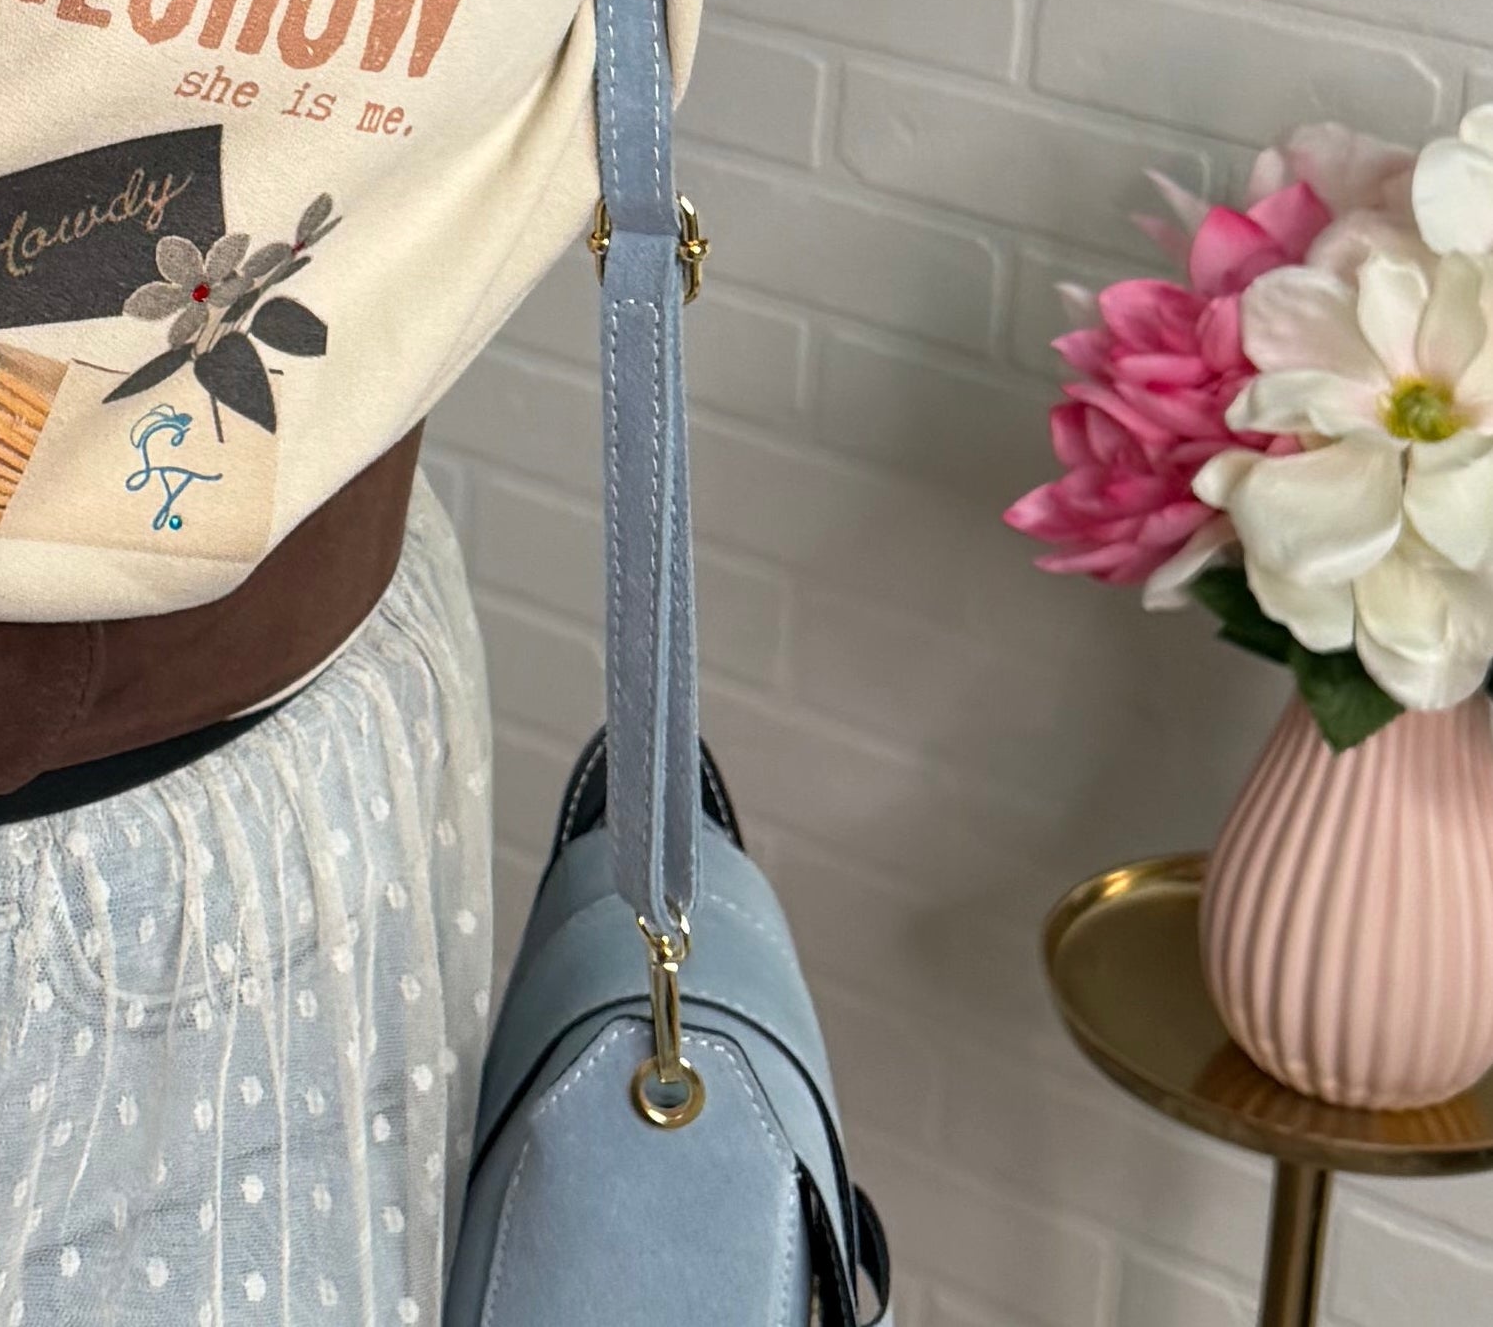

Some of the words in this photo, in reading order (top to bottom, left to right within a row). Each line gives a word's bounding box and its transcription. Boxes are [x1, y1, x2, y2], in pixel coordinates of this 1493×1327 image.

[174, 65, 260, 109] she
[280, 81, 337, 120] is
[355, 100, 413, 138] me.
